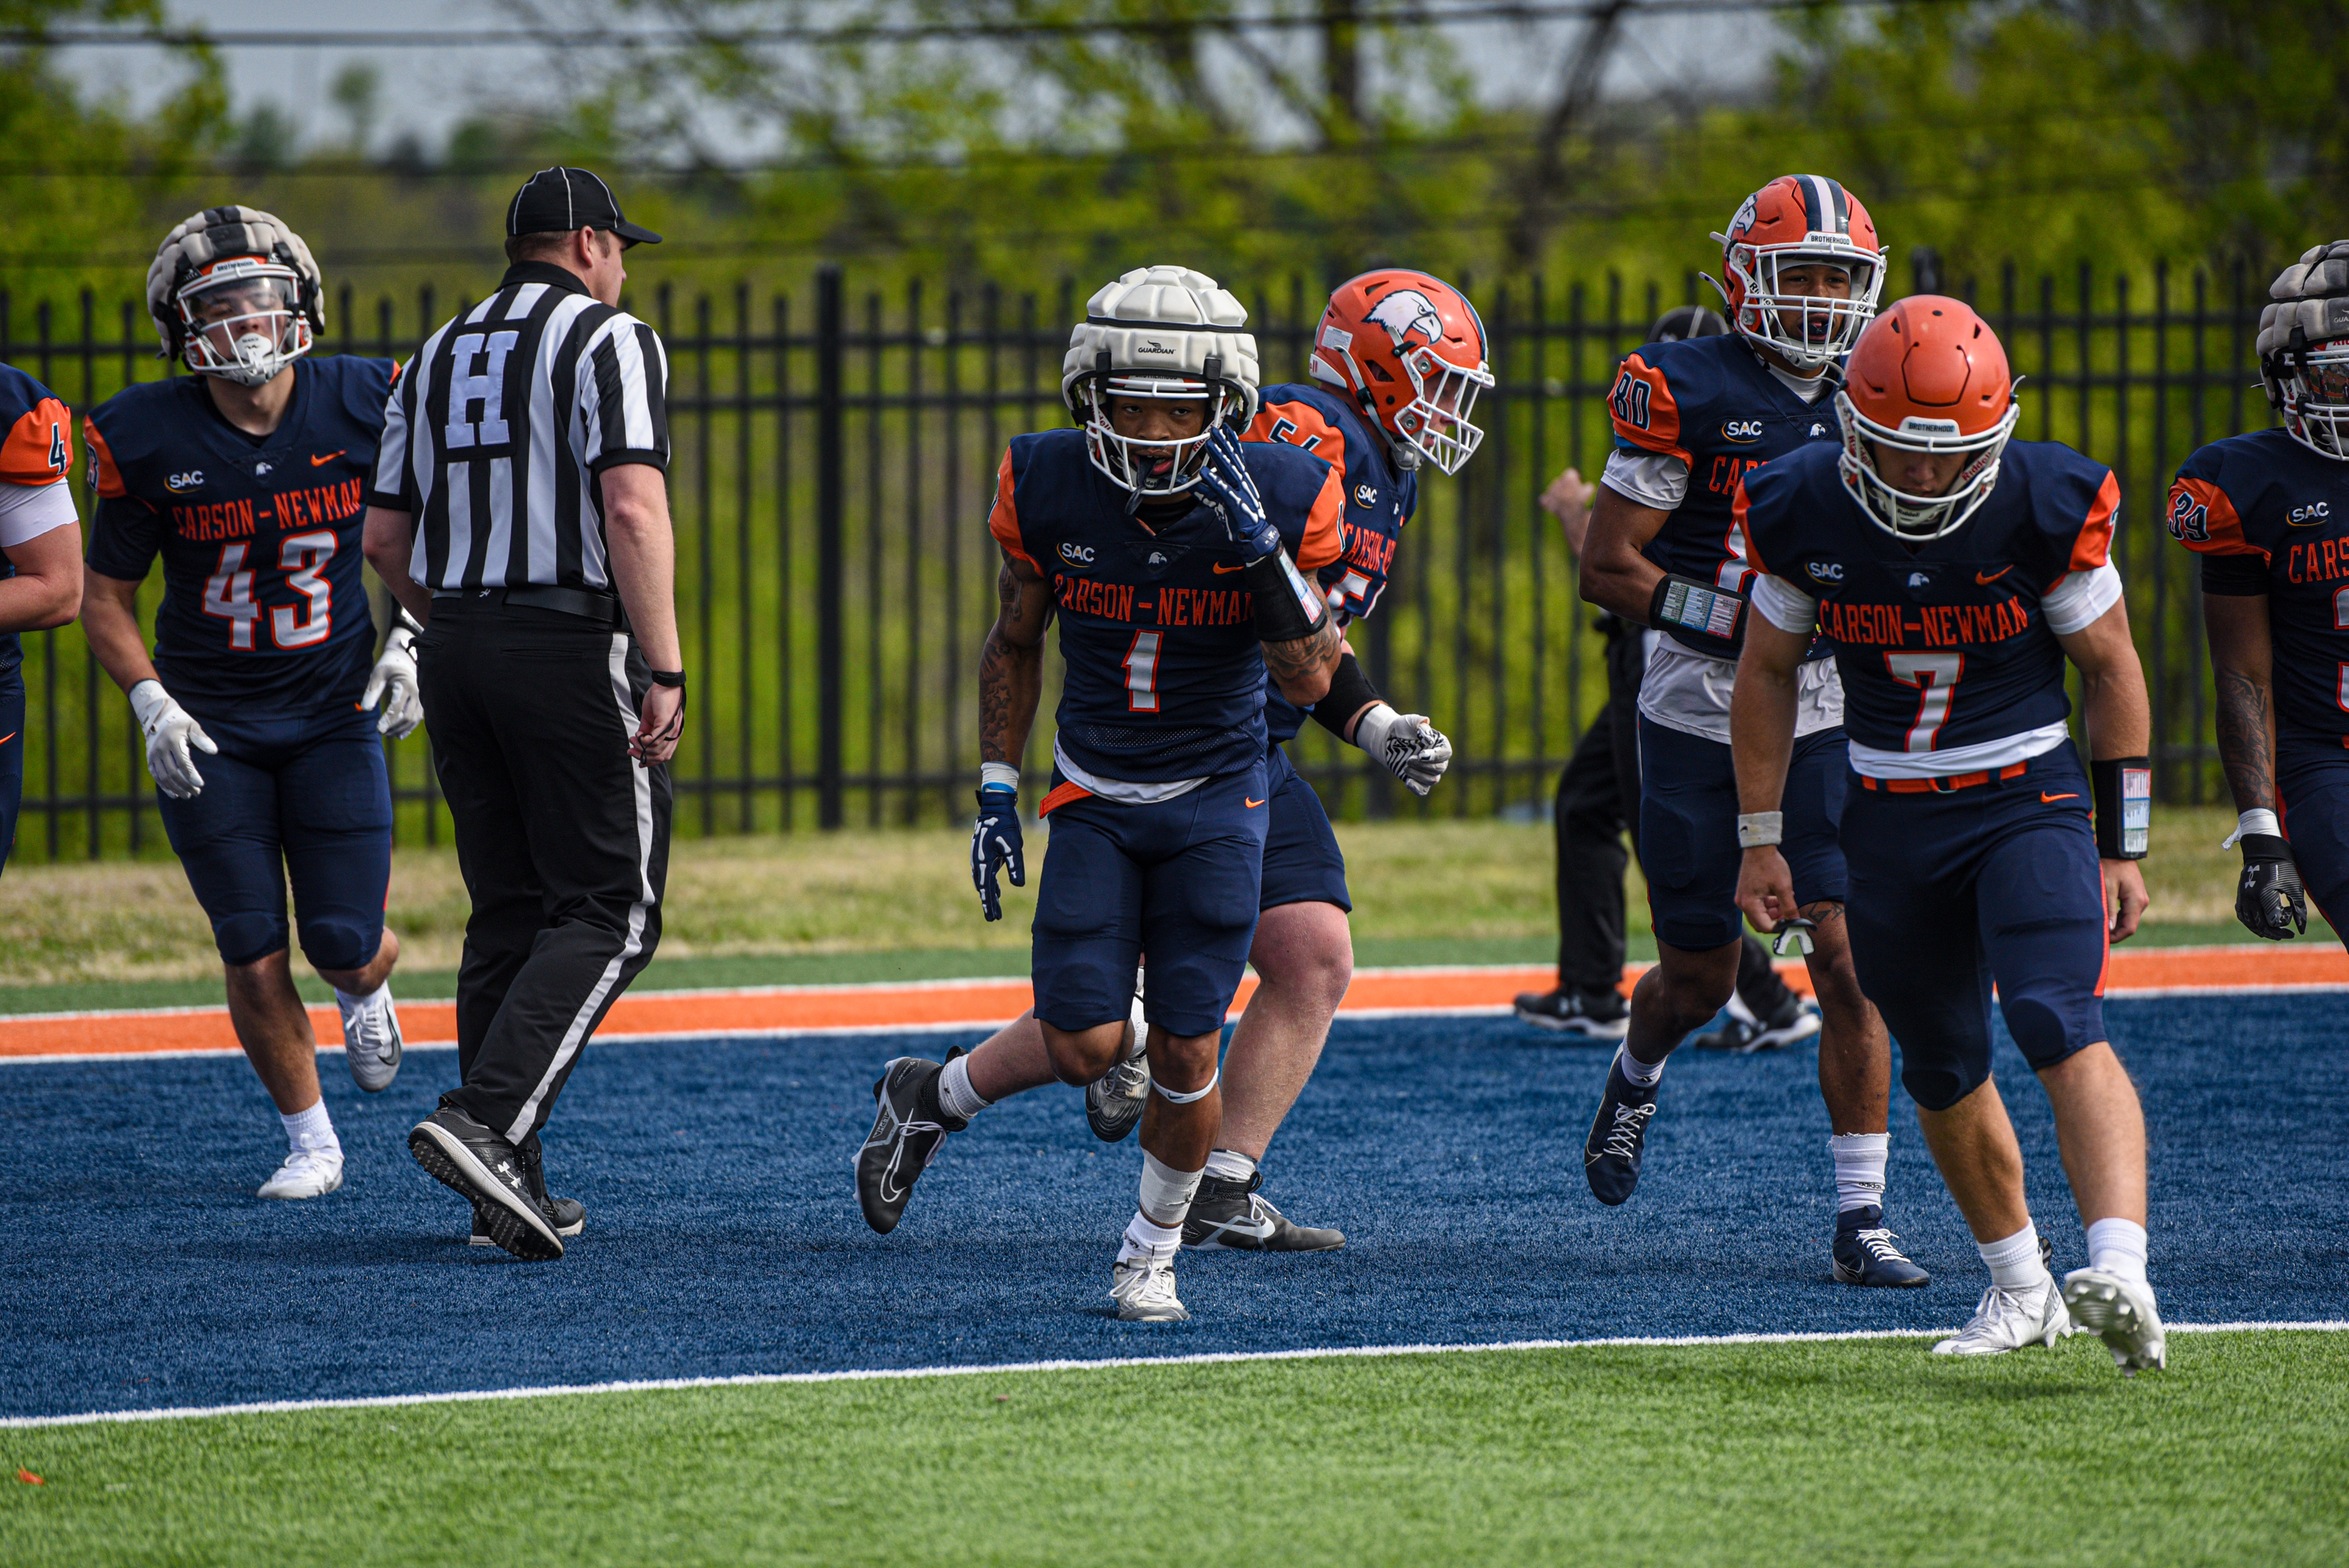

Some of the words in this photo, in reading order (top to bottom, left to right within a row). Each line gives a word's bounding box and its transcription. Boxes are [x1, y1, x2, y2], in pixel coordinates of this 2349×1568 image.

[1810, 234, 1850, 246] BROTHERHOOD
[1138, 347, 1175, 355] GUARDIAN
[445, 330, 520, 449] H
[1613, 371, 1651, 431] 80
[1727, 420, 1763, 437] SAC
[1908, 422, 1955, 433] BROTHERHOOD
[48, 421, 67, 475] 4
[169, 470, 204, 489] SAC
[1357, 484, 1378, 504] SAC
[2291, 501, 2330, 522] SAC
[1061, 543, 1095, 563] SAC
[1808, 562, 1844, 579] SAC
[202, 527, 339, 651] 43
[1819, 595, 2028, 647] CARSON-NEWMAN
[1121, 628, 1164, 712] 1
[1882, 650, 1965, 753] 7
